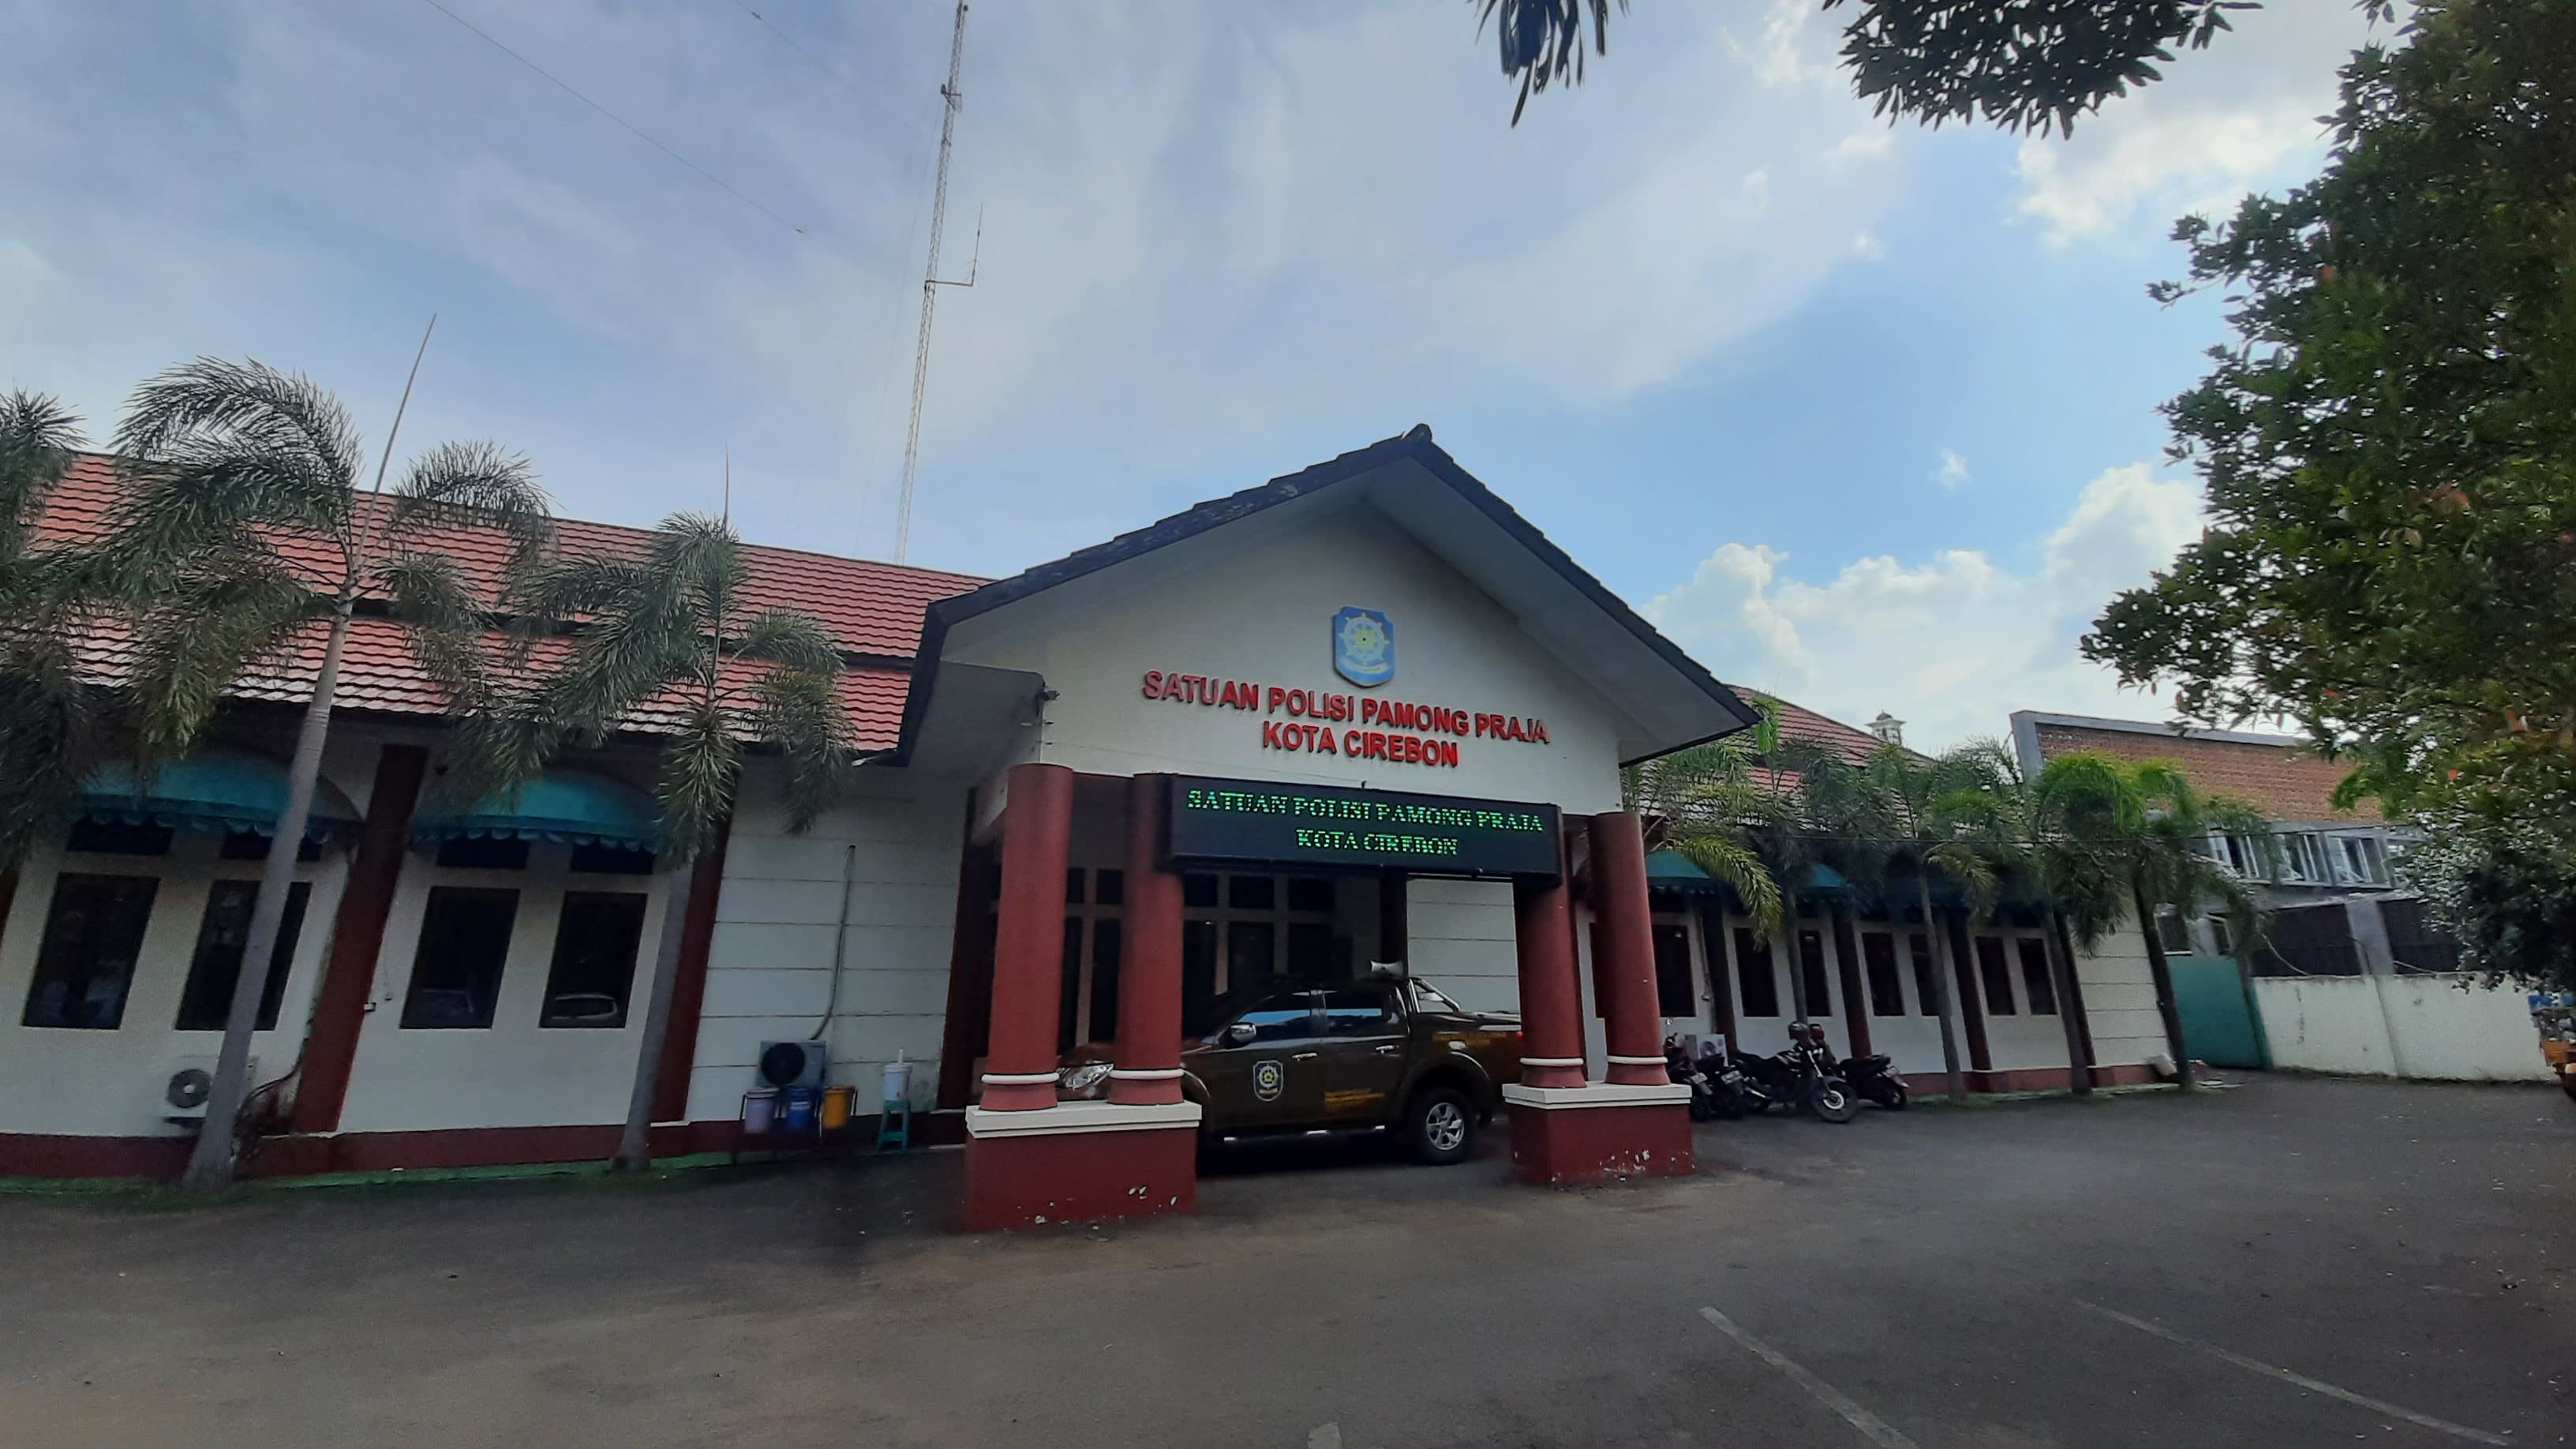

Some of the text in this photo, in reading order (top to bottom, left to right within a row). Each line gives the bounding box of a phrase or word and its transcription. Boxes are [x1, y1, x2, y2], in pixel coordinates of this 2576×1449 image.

[1143, 670, 1550, 744] SATUAN POLISI PAMONG PRAJA
[1264, 721, 1458, 767] KOTA CIREBON
[1187, 789, 1543, 832] SATUAN POLISI PAMONG PRAJA
[1296, 829, 1458, 856] KOTA CIREBON
